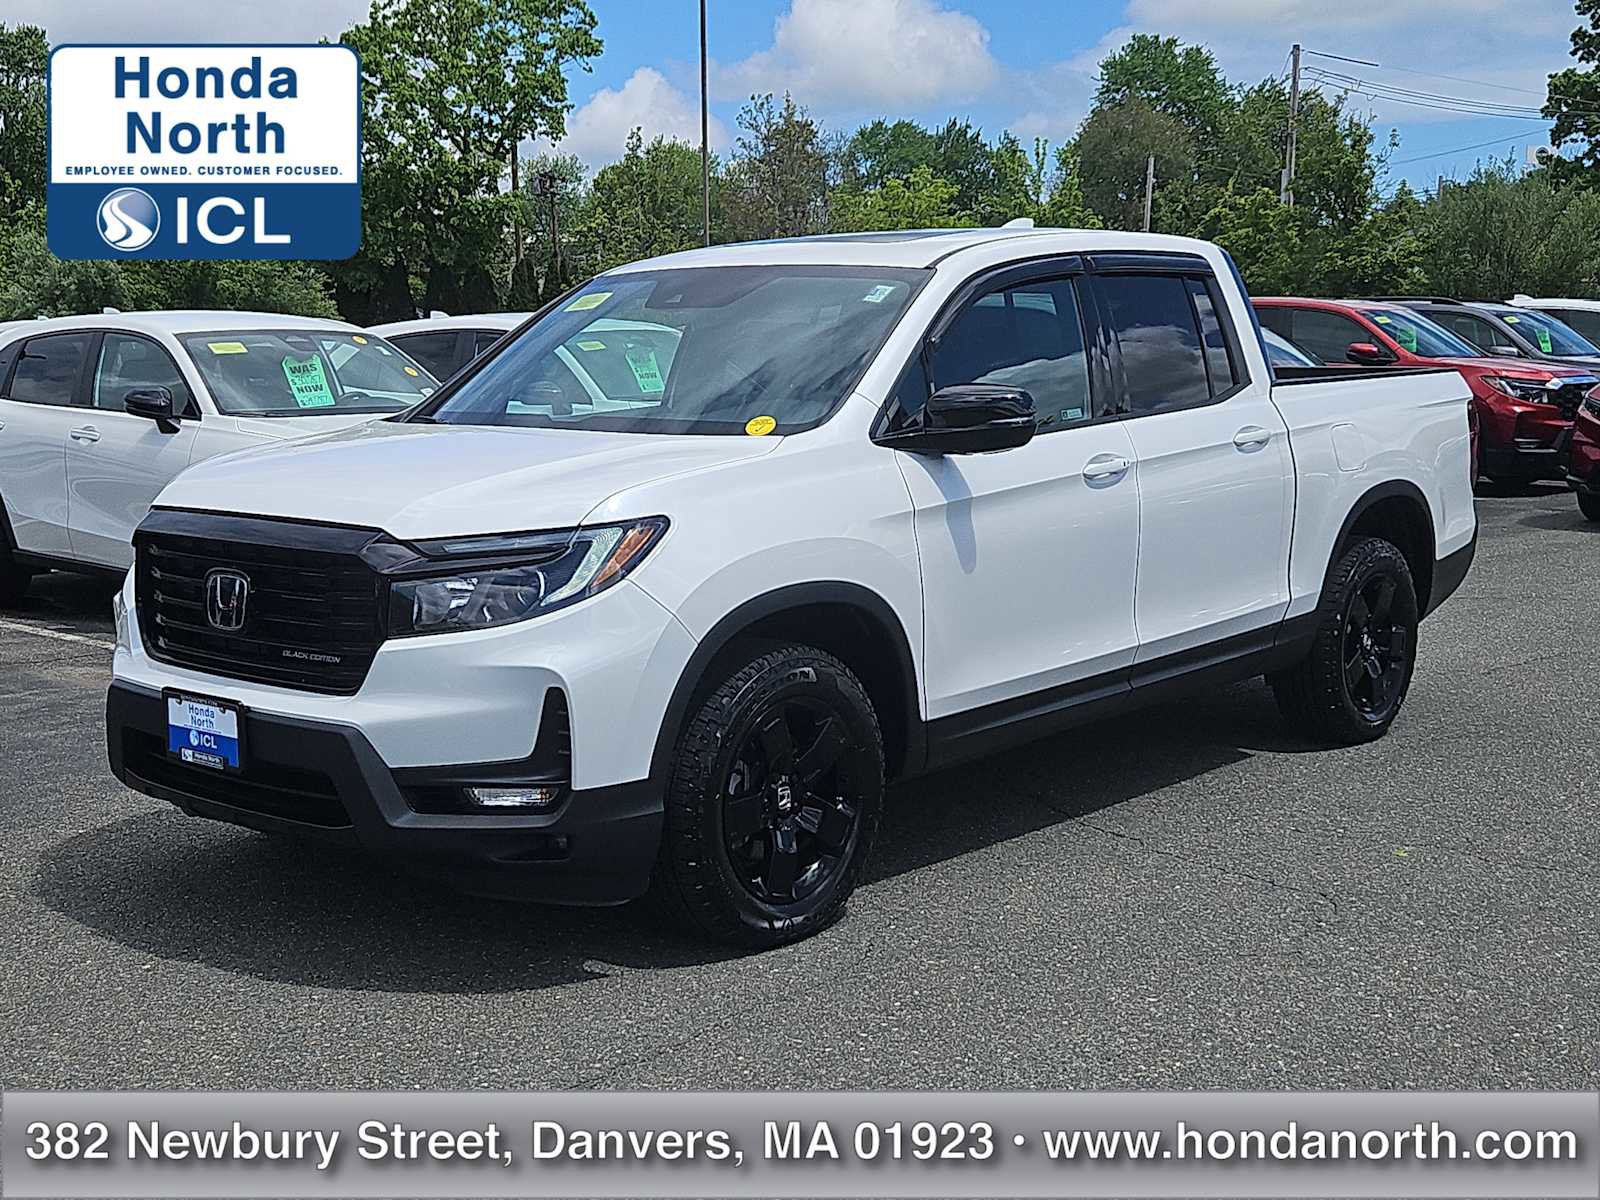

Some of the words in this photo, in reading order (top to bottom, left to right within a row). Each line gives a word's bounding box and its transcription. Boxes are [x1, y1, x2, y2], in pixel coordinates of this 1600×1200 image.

[290, 363, 318, 374] WAS
[296, 383, 324, 394] NOW
[188, 703, 215, 719] Honda
[190, 714, 214, 729] North
[200, 733, 218, 749] ICL
